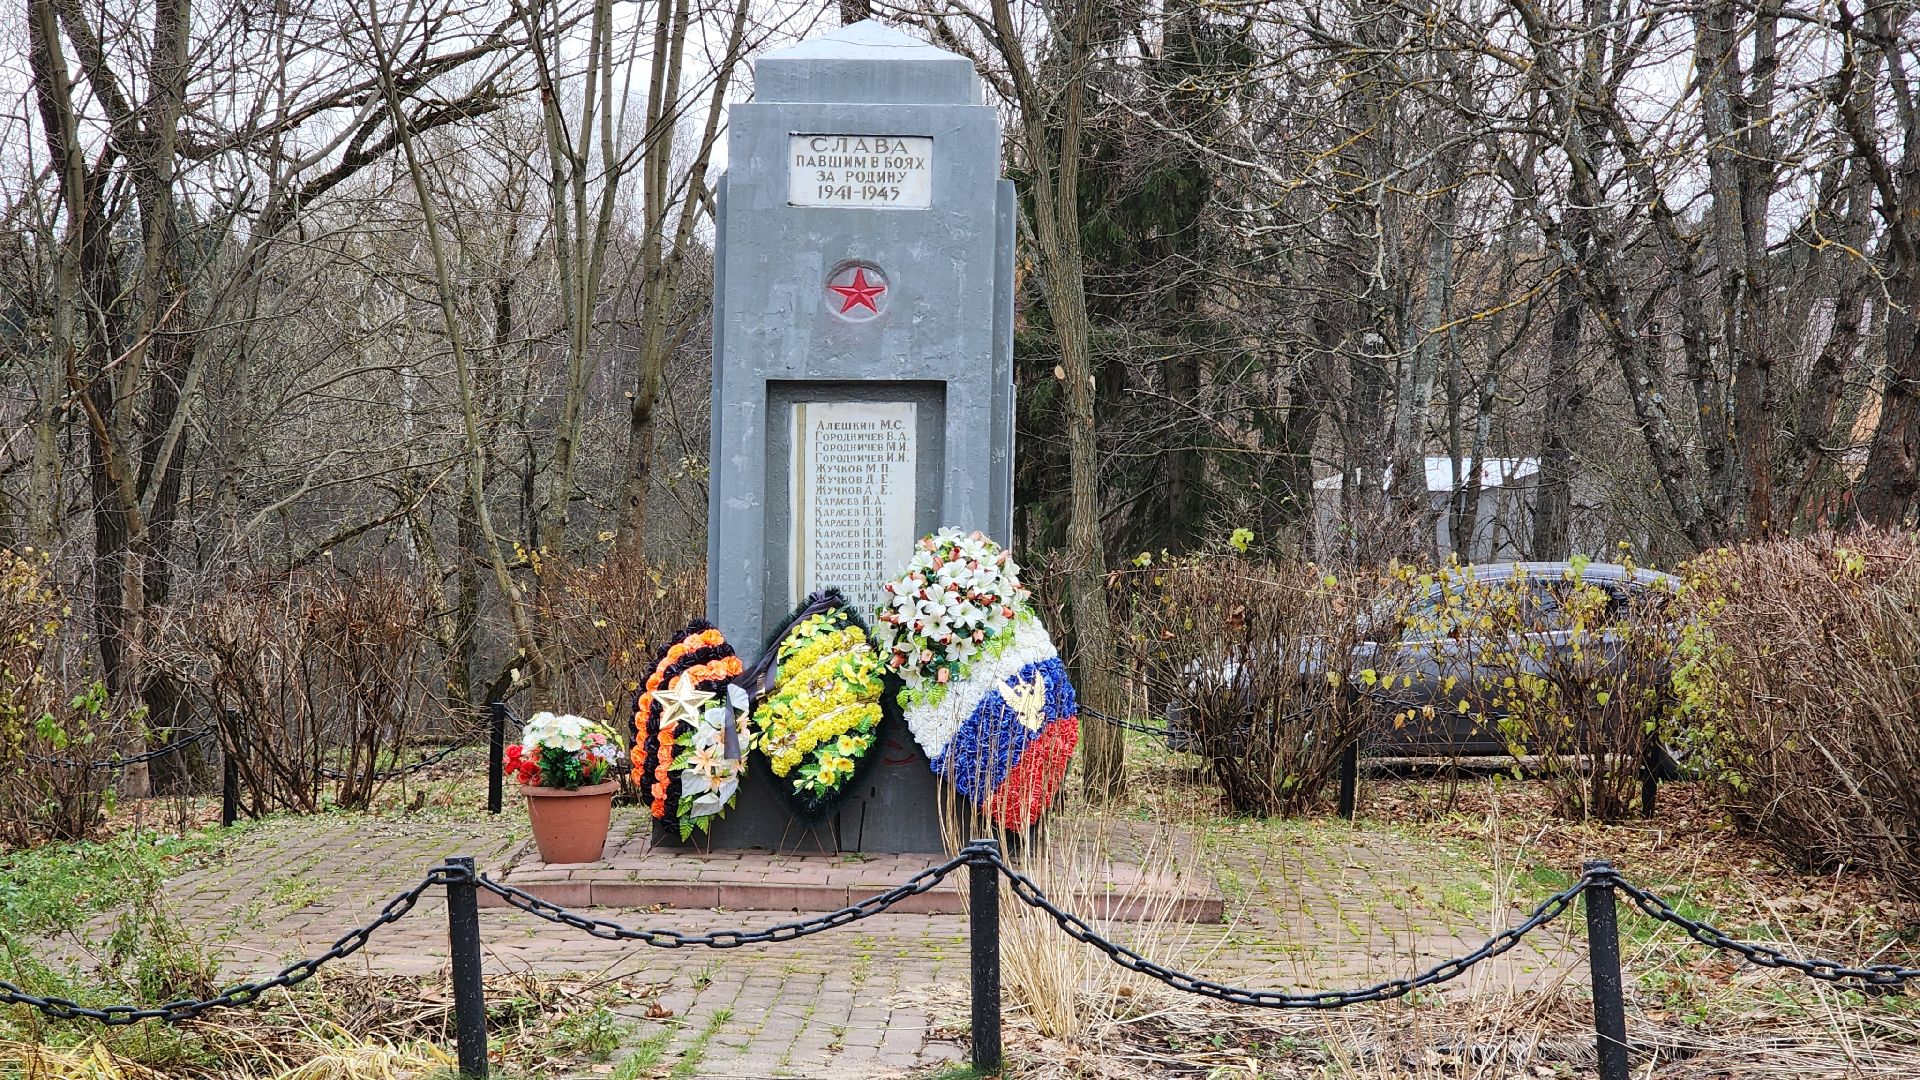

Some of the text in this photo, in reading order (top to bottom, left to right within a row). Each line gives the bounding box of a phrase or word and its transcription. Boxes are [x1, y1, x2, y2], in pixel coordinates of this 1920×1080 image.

[810, 136, 909, 154] СЛАВА
[796, 155, 925, 169] ПАВШИМ В БОЯХ
[817, 171, 908, 183] ЗА РОДИНУ
[818, 185, 900, 201] 1941-1945
